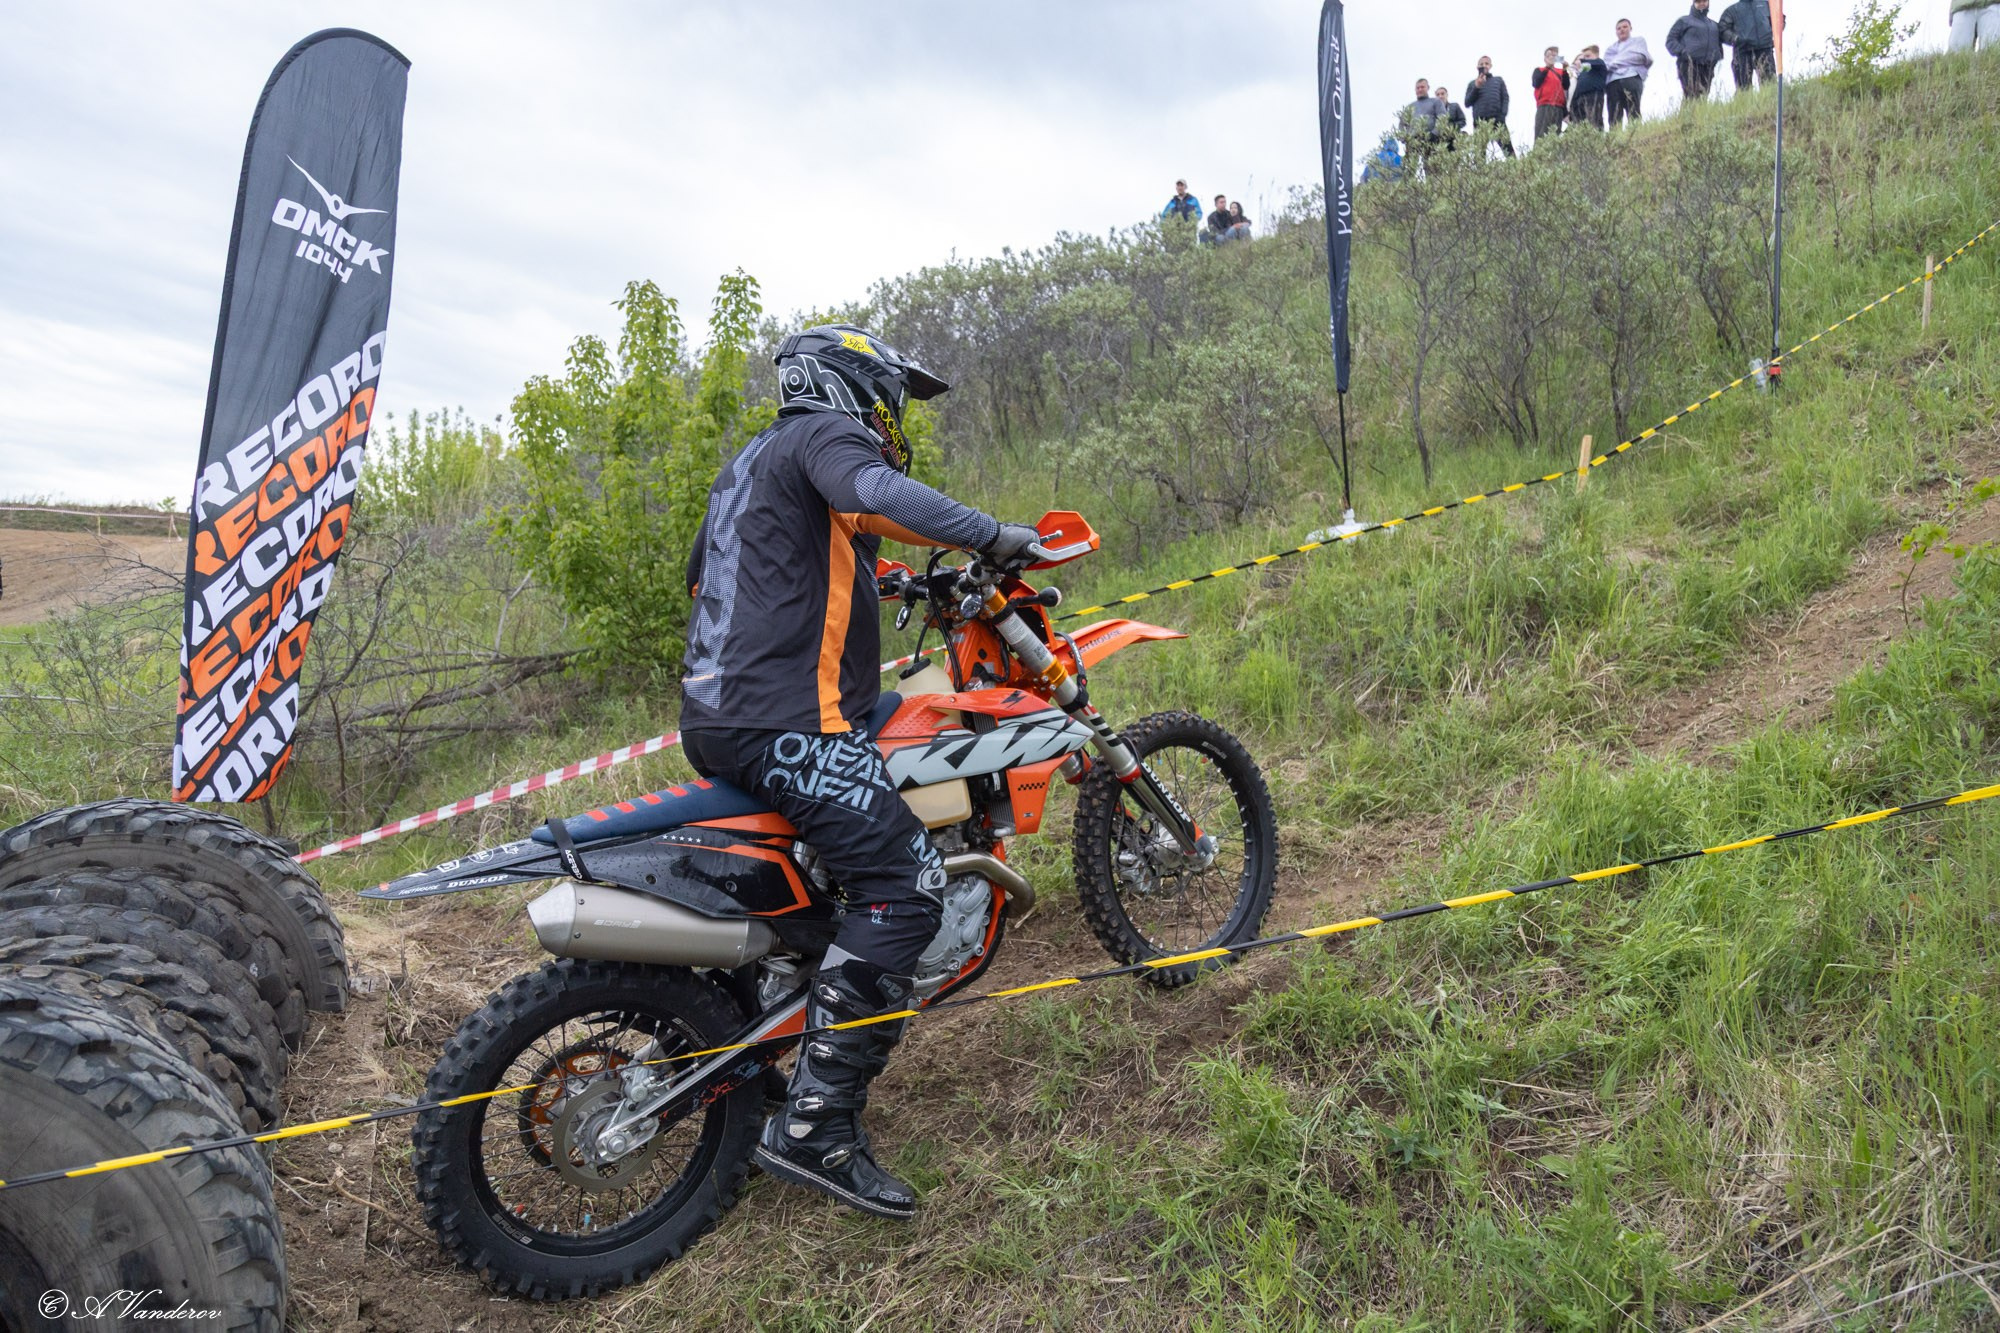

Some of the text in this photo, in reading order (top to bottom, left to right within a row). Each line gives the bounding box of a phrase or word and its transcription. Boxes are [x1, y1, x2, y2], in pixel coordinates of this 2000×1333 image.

[271, 198, 390, 275] ОМСК
[195, 330, 387, 524] RECORD
[195, 387, 375, 576] RECORD
[1140, 761, 1191, 823] DUNLOP
[446, 874, 509, 889] DUNLOP
